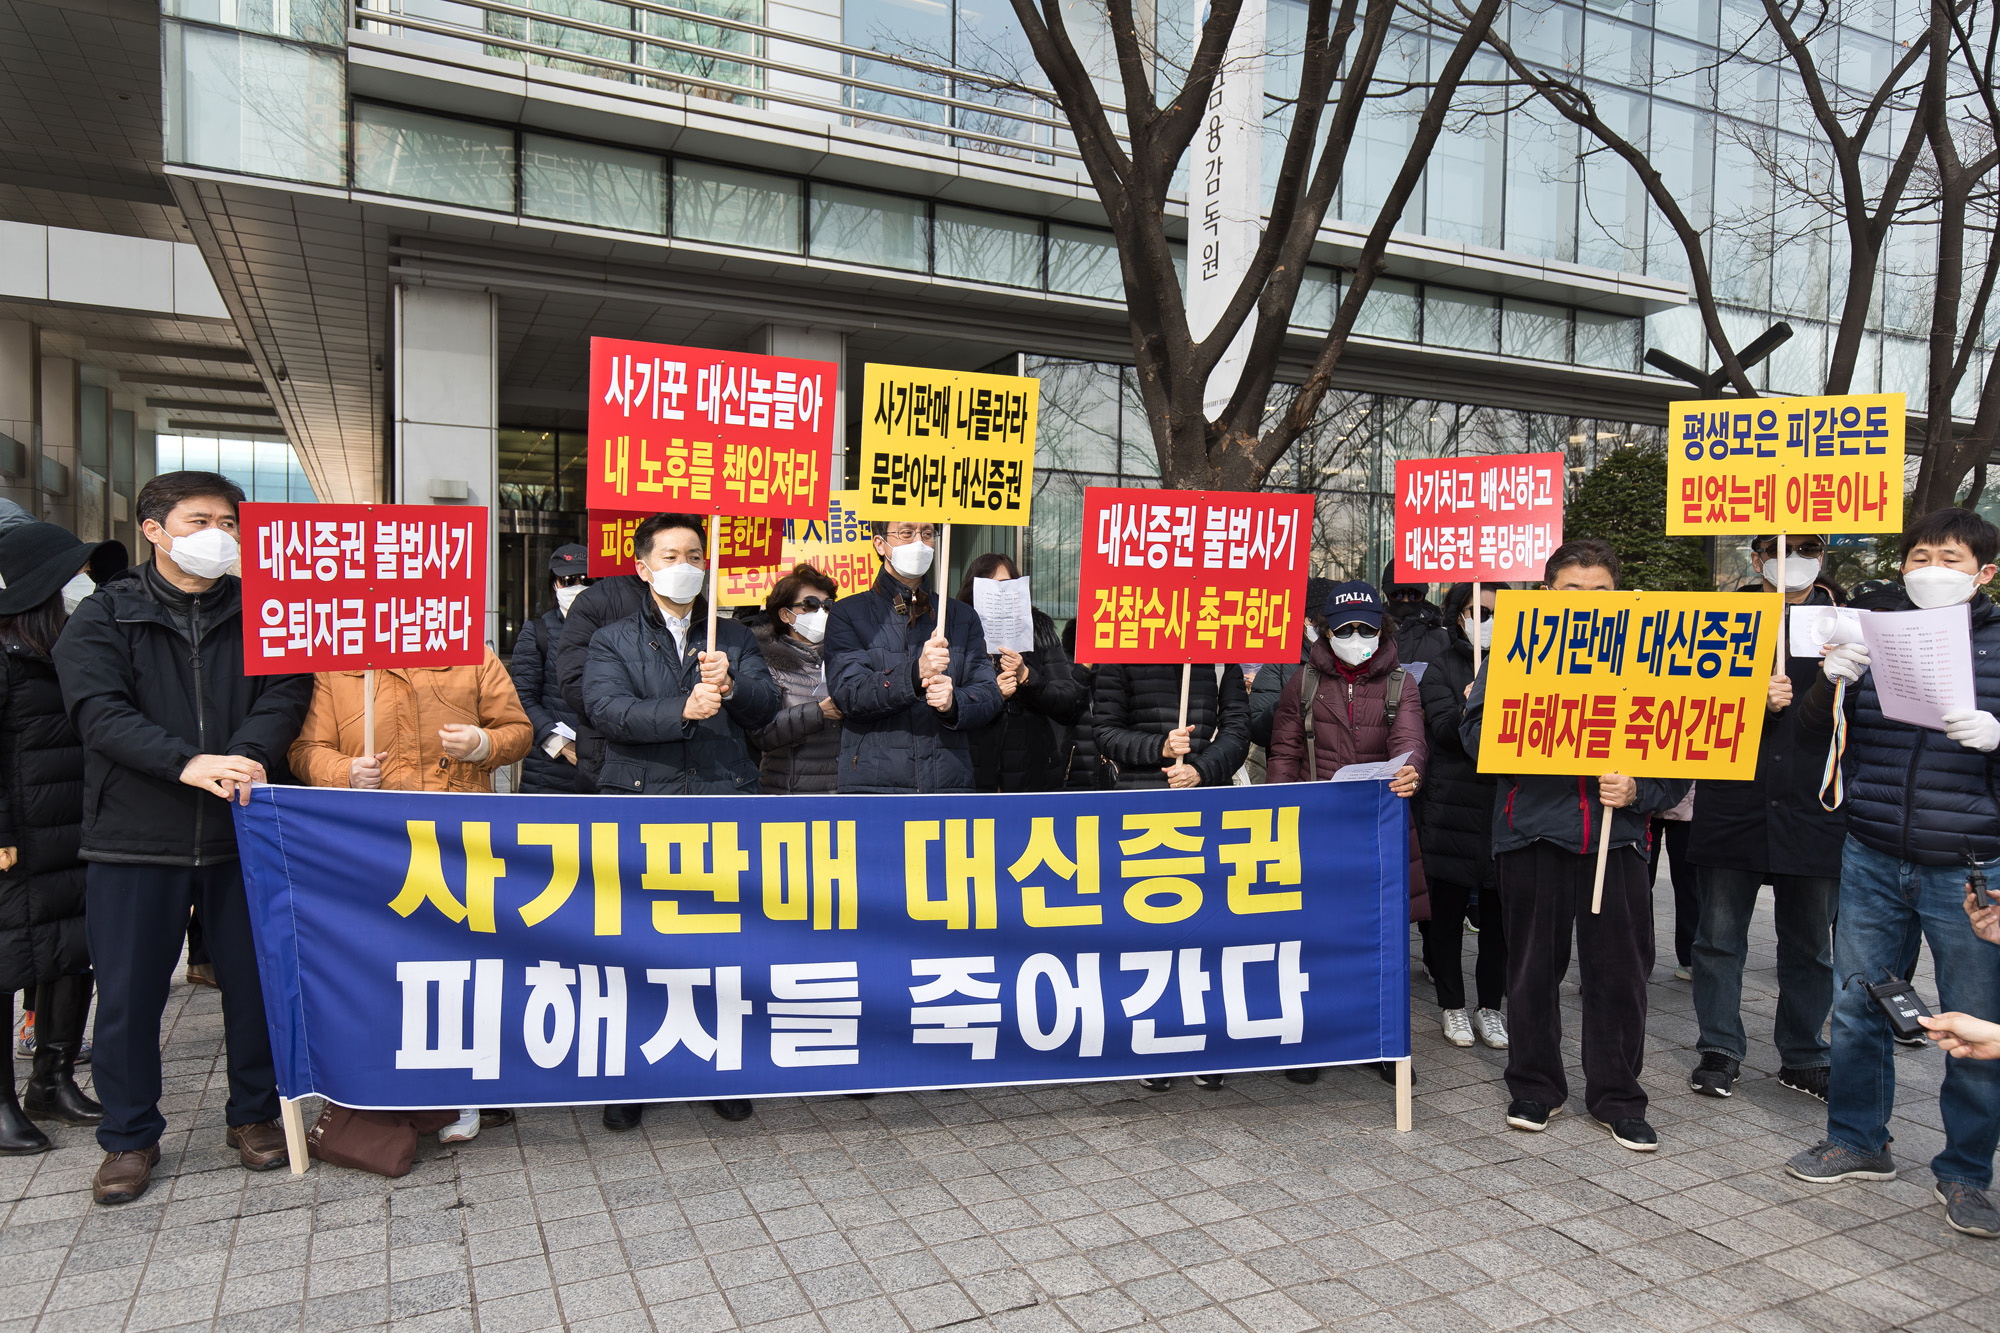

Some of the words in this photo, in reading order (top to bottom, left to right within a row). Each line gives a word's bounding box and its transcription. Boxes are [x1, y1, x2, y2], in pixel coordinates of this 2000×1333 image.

[605, 355, 688, 421] 사기꾼
[697, 364, 823, 433] 대신놈들아
[874, 380, 951, 439] 사기판매
[956, 388, 1028, 444] 나몰라라
[1683, 410, 1779, 461] 평생모은
[1787, 407, 1889, 458] 피같은돈
[604, 436, 630, 497] 내
[636, 438, 715, 501] 노후를
[722, 444, 819, 507] 책임져라
[871, 453, 947, 508] 문닫아라
[952, 457, 1023, 511] 대신증권
[1405, 469, 1475, 515] 사기치고
[1481, 466, 1553, 511] 배신하고
[1682, 474, 1776, 524] 믿었는데
[1787, 472, 1888, 523] 이꼴이냐
[259, 520, 365, 582] 대신증권
[373, 520, 473, 580] 불법사기
[1098, 503, 1197, 569] 대신증권
[1203, 506, 1299, 571] 불법사기
[1406, 526, 1474, 571] 대신증권
[1479, 523, 1552, 570] 폭망해라
[259, 598, 366, 658] 은퇴자금
[375, 596, 472, 654] 다날렸다
[1093, 586, 1191, 650] 검찰수사
[1196, 586, 1291, 650] 촉구한다
[1335, 591, 1373, 605] ITALIA
[1507, 608, 1630, 677] 사기판매
[1637, 610, 1762, 679] 대신증권
[1498, 693, 1617, 759] 피해자들
[1625, 696, 1746, 763] 죽어간다
[388, 819, 858, 936] 사기판매
[905, 807, 1303, 930] 대신증권
[396, 959, 862, 1080] 피해자들
[909, 941, 1310, 1058] 죽어간다
